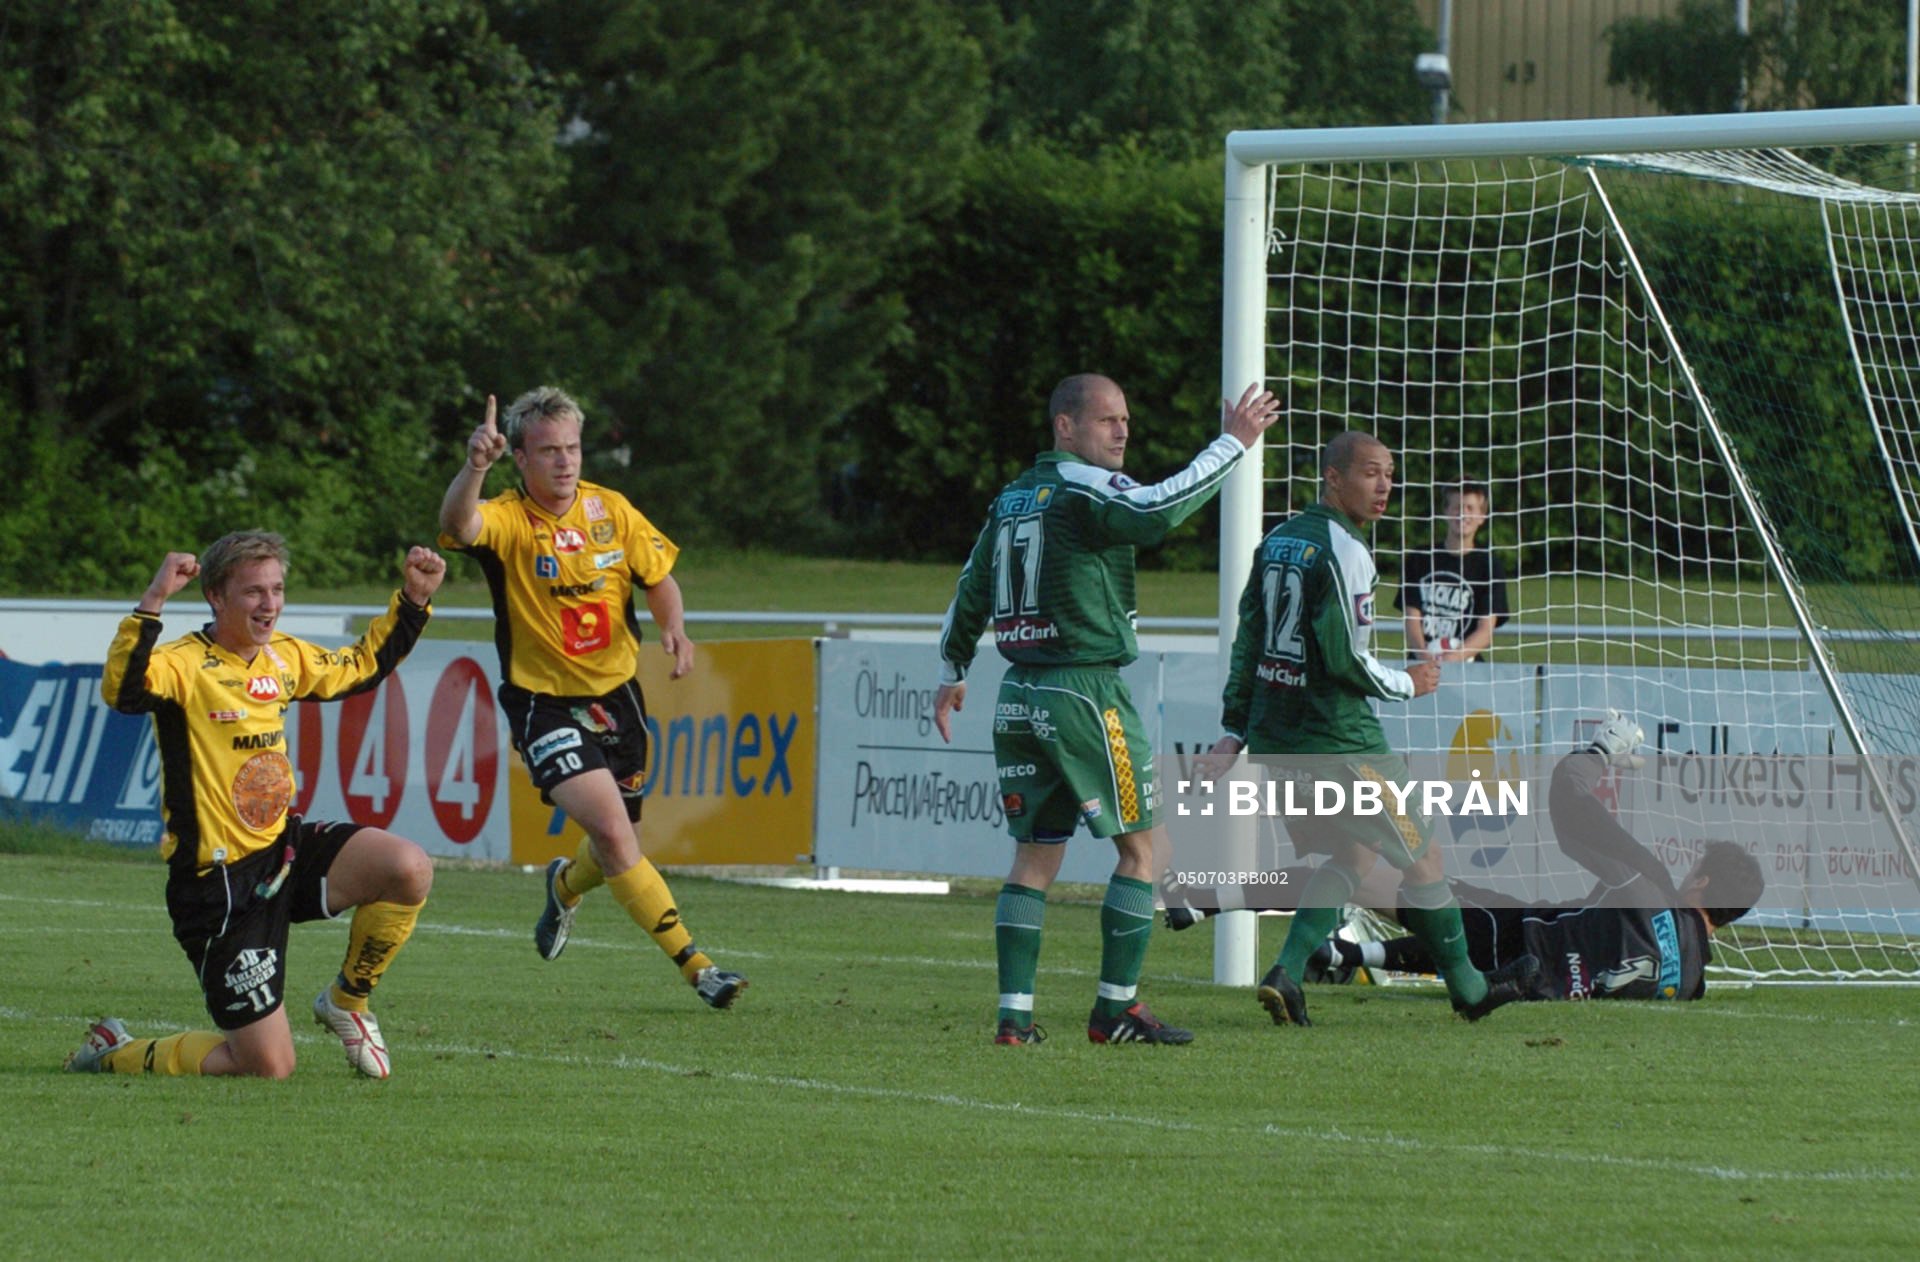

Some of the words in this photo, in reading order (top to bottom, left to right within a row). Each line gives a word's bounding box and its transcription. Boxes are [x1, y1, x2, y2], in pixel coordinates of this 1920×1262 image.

[993, 512, 1045, 618] 17
[996, 622, 1059, 642] ordClark
[1262, 563, 1306, 663] 12
[855, 659, 937, 737] Öhrling
[348, 682, 390, 813] 4
[436, 676, 481, 820] 4
[556, 752, 583, 775] 10
[643, 711, 798, 798] onnex
[998, 763, 1037, 779] WECO
[1655, 722, 1805, 809] Folkets
[851, 761, 1004, 828] PRICEWATERHOUS
[1776, 844, 1804, 872] BIO
[248, 984, 276, 1012] 11
